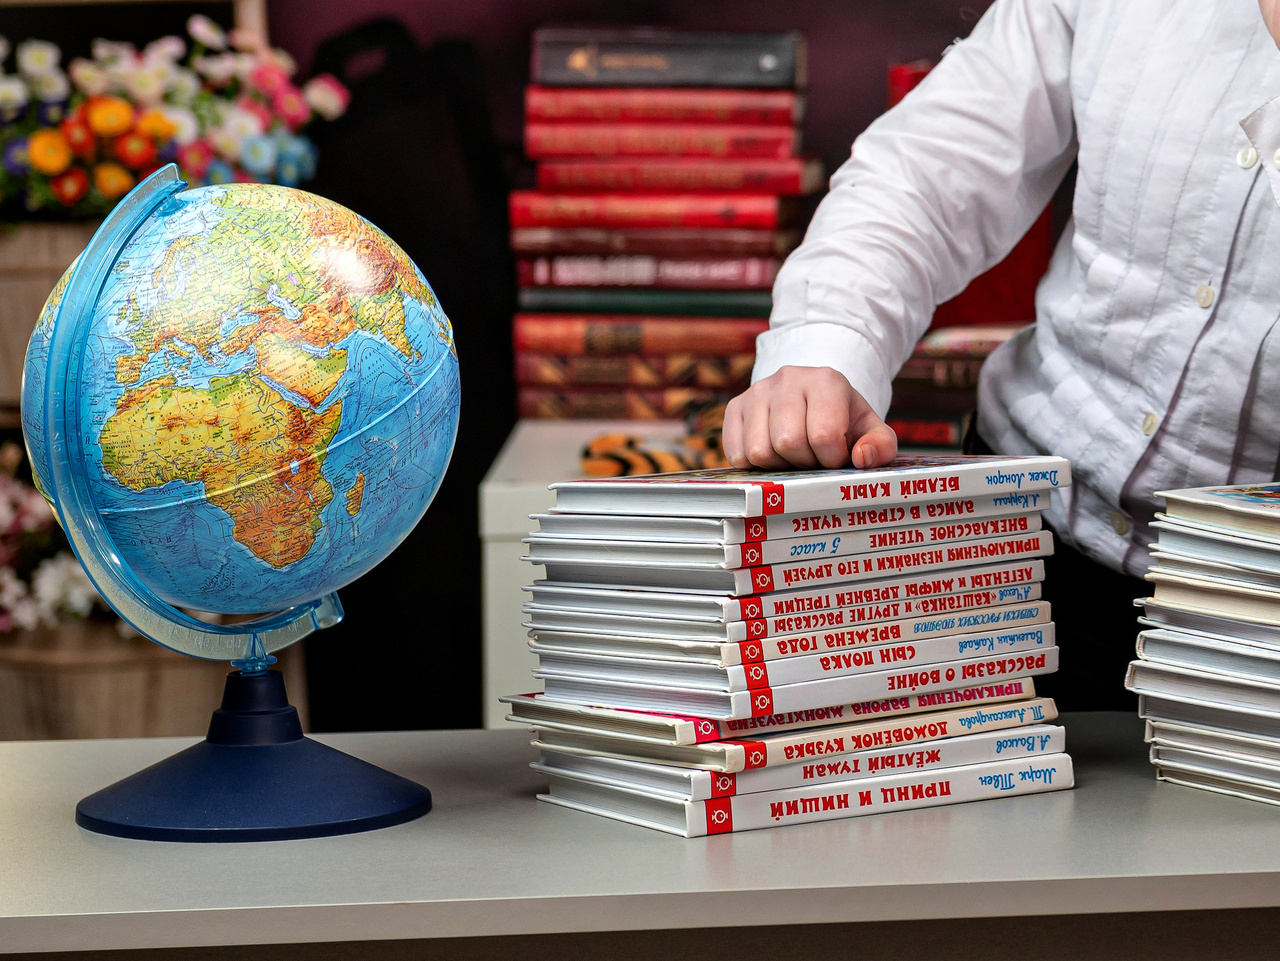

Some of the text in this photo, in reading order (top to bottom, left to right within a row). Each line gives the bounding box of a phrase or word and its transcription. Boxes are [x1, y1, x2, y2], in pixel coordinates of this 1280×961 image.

[840, 469, 1059, 501] Джек Лондон БЕЛЫЙ КЛЫК
[847, 506, 906, 529] СТРАНЕ
[910, 506, 920, 520] В
[926, 500, 974, 517] АЛИСА
[792, 515, 841, 533] ЧУДЕС
[790, 517, 1028, 557] ВНЕКЛАССНОЕ ЧТЕНИЕ 5 класс
[783, 538, 1040, 586] ПРИКЛЮЧЕНИЯ НЕЗНАЙКИ И ЕГО ДРУЗЕЙ
[906, 577, 954, 597] МИФЫ
[970, 567, 1033, 588] ЛЕГЕНДЫ
[774, 595, 831, 614] ГРЕЦИИ
[836, 586, 900, 608] ДРЕВНЕЙ
[774, 611, 843, 633] РАССКАЗЫ
[849, 603, 900, 622] ДРУГИЕ
[777, 637, 817, 655] ГОДА
[824, 625, 900, 647] ВРЕМЕНА
[820, 630, 1043, 672] Валентин Катаев СЫН ПОЛКА
[887, 654, 1046, 692] РАССКАЗЫ О ВОЙНЕ
[851, 696, 909, 716] БАРОНА
[917, 682, 1023, 708] ПРИКЛЮЧЕНИЯ
[959, 708, 1026, 728] Александрова
[851, 721, 948, 750] ДОМОВЁНОК
[784, 737, 844, 760] КУЗЬКА
[803, 759, 860, 779] ТУМАН
[868, 749, 941, 774] ЖЁЛТЫЙ
[769, 766, 1056, 820] Марк Твен ПРИНЦ И НИЩИЙ
